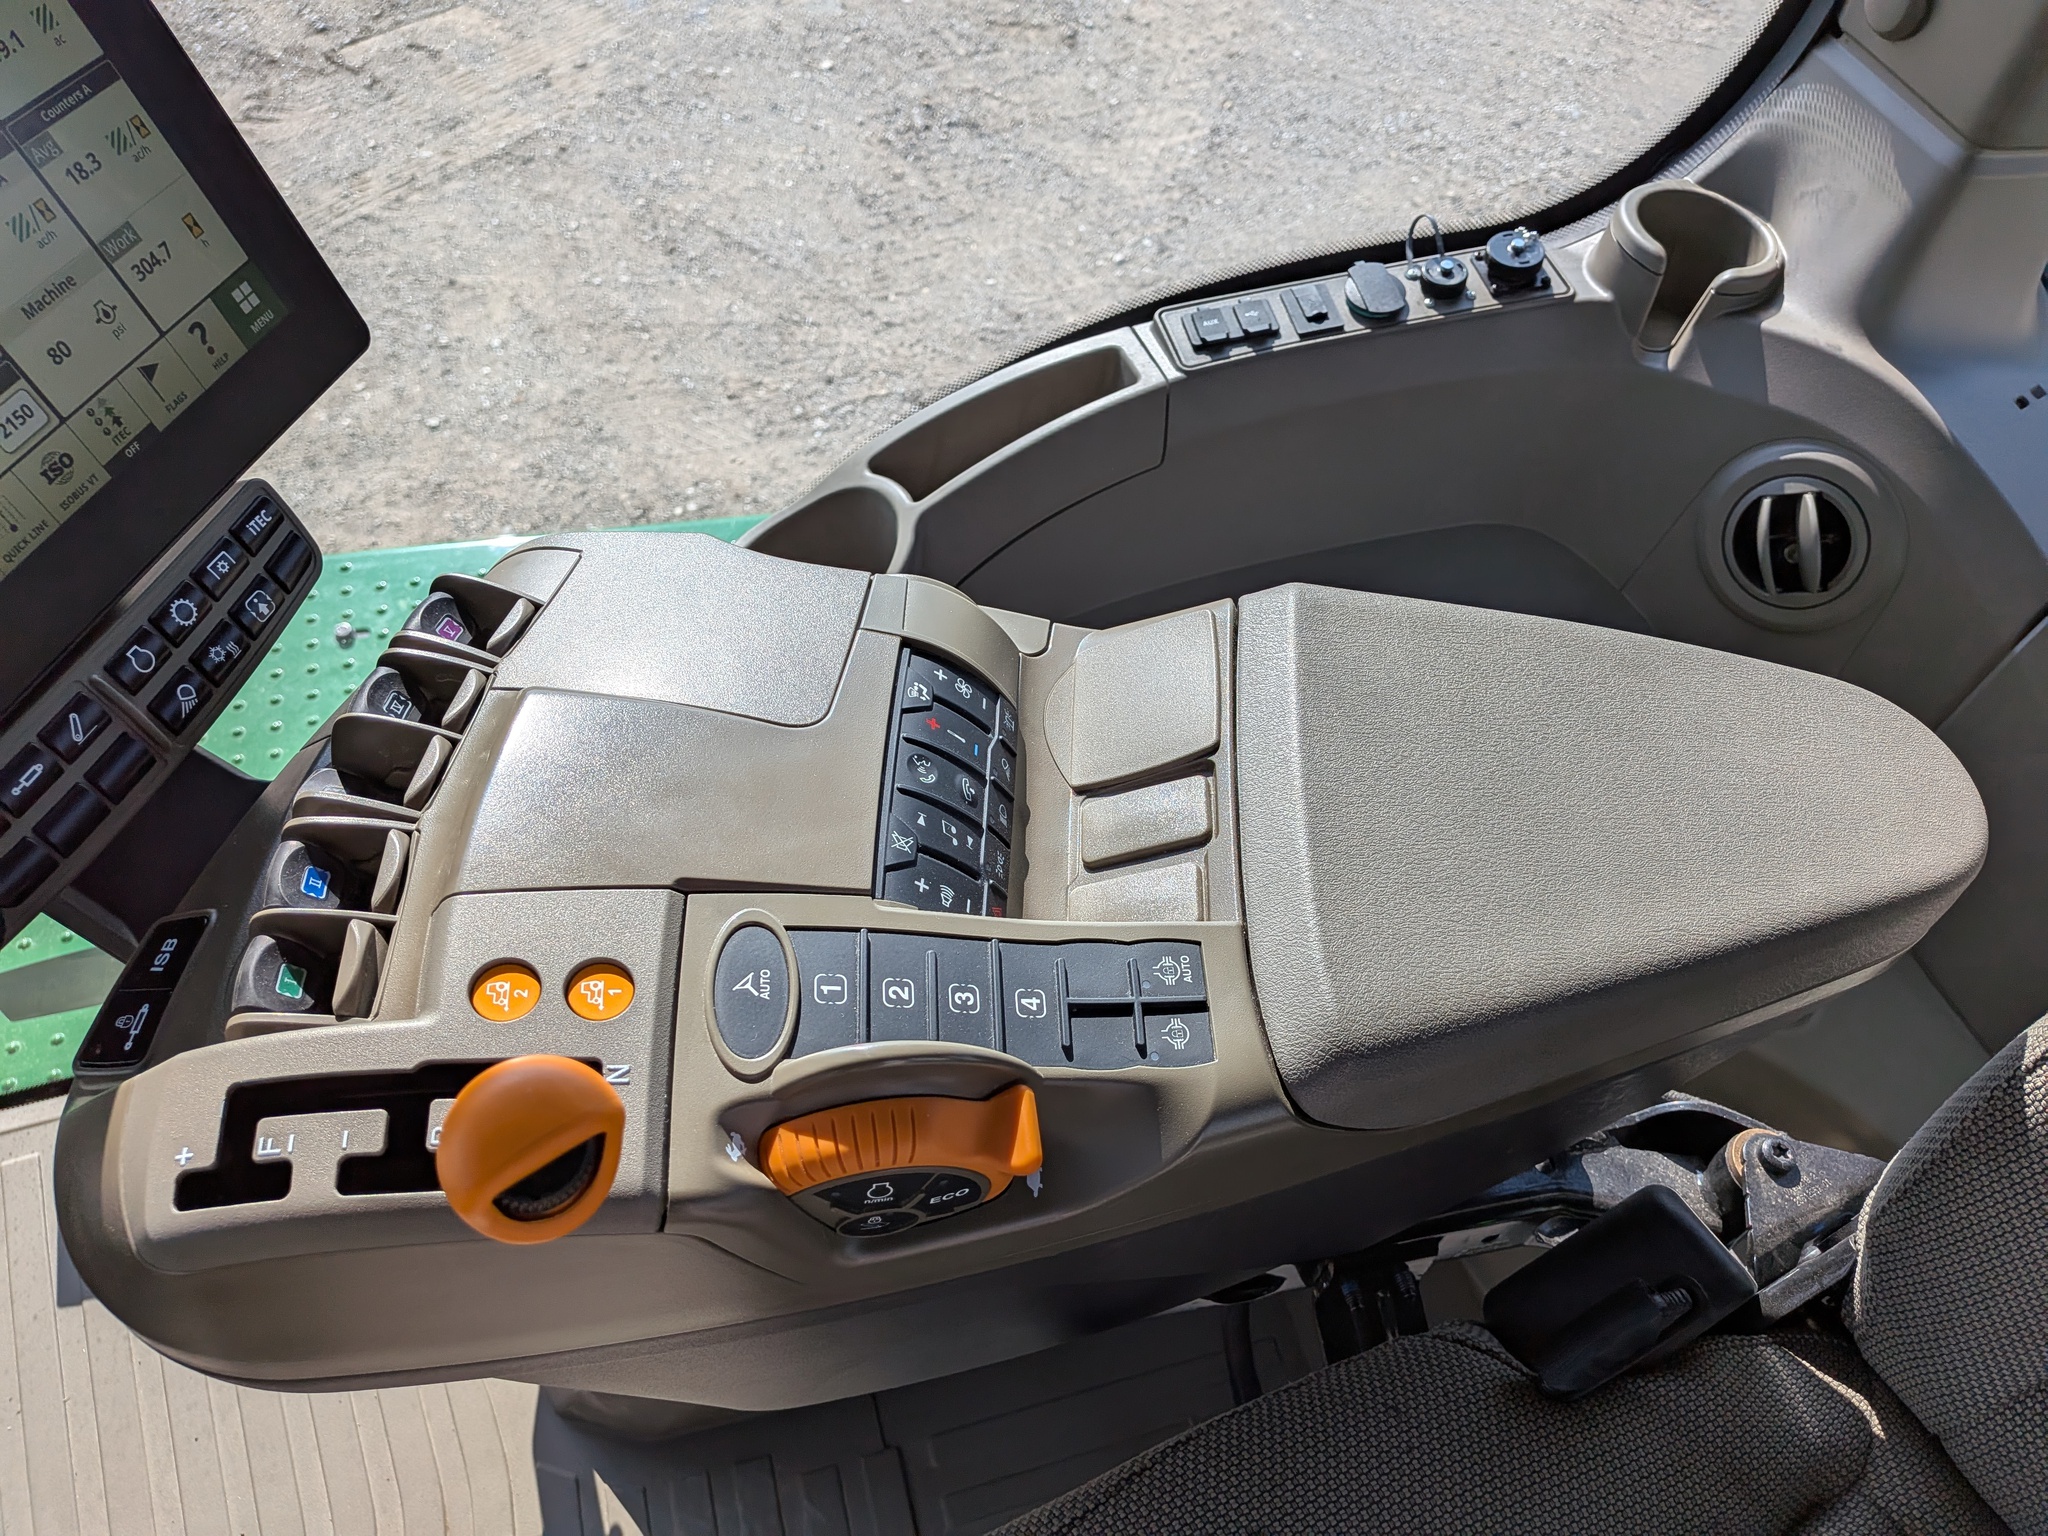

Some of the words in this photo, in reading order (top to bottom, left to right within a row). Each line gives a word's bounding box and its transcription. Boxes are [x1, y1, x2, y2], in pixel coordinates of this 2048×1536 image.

[0, 29, 25, 61] 9.1
[53, 34, 67, 47] ac
[40, 89, 84, 121] Counters
[81, 83, 93, 97] A
[33, 142, 61, 165] Avg
[131, 144, 152, 163] ac/h
[65, 152, 102, 185] 18.3
[37, 229, 58, 249] ac/h
[102, 230, 138, 257] Work
[200, 238, 210, 248] h
[130, 241, 172, 283] 304.7
[20, 275, 77, 321] Machine
[112, 322, 128, 341] psi
[250, 309, 275, 334] MENU
[1202, 318, 1220, 327] AUX
[46, 340, 72, 365] 80
[212, 352, 230, 371] HELP
[165, 391, 188, 414] FLAGS
[0, 403, 35, 440] 2150
[111, 426, 132, 447] ITEC
[124, 440, 141, 458] OFF
[40, 452, 75, 486] ISO
[59, 483, 89, 512] ISOBUS
[246, 509, 273, 536] iTEC
[2, 536, 31, 564] QUICK
[28, 519, 50, 541] LINE
[390, 700, 405, 715] IV
[150, 938, 178, 972] ISB
[1180, 955, 1193, 983] AUTO
[513, 988, 529, 998] 2
[607, 988, 622, 996] 1
[759, 969, 771, 1000] AUTO
[820, 983, 842, 995] 1
[888, 986, 909, 1000] 2
[954, 992, 975, 1006] 3
[1020, 997, 1041, 1011] 4
[606, 1064, 630, 1085] N
[257, 1137, 282, 1157] F
[864, 1196, 894, 1204] n/min
[929, 1188, 970, 1205] ECO
